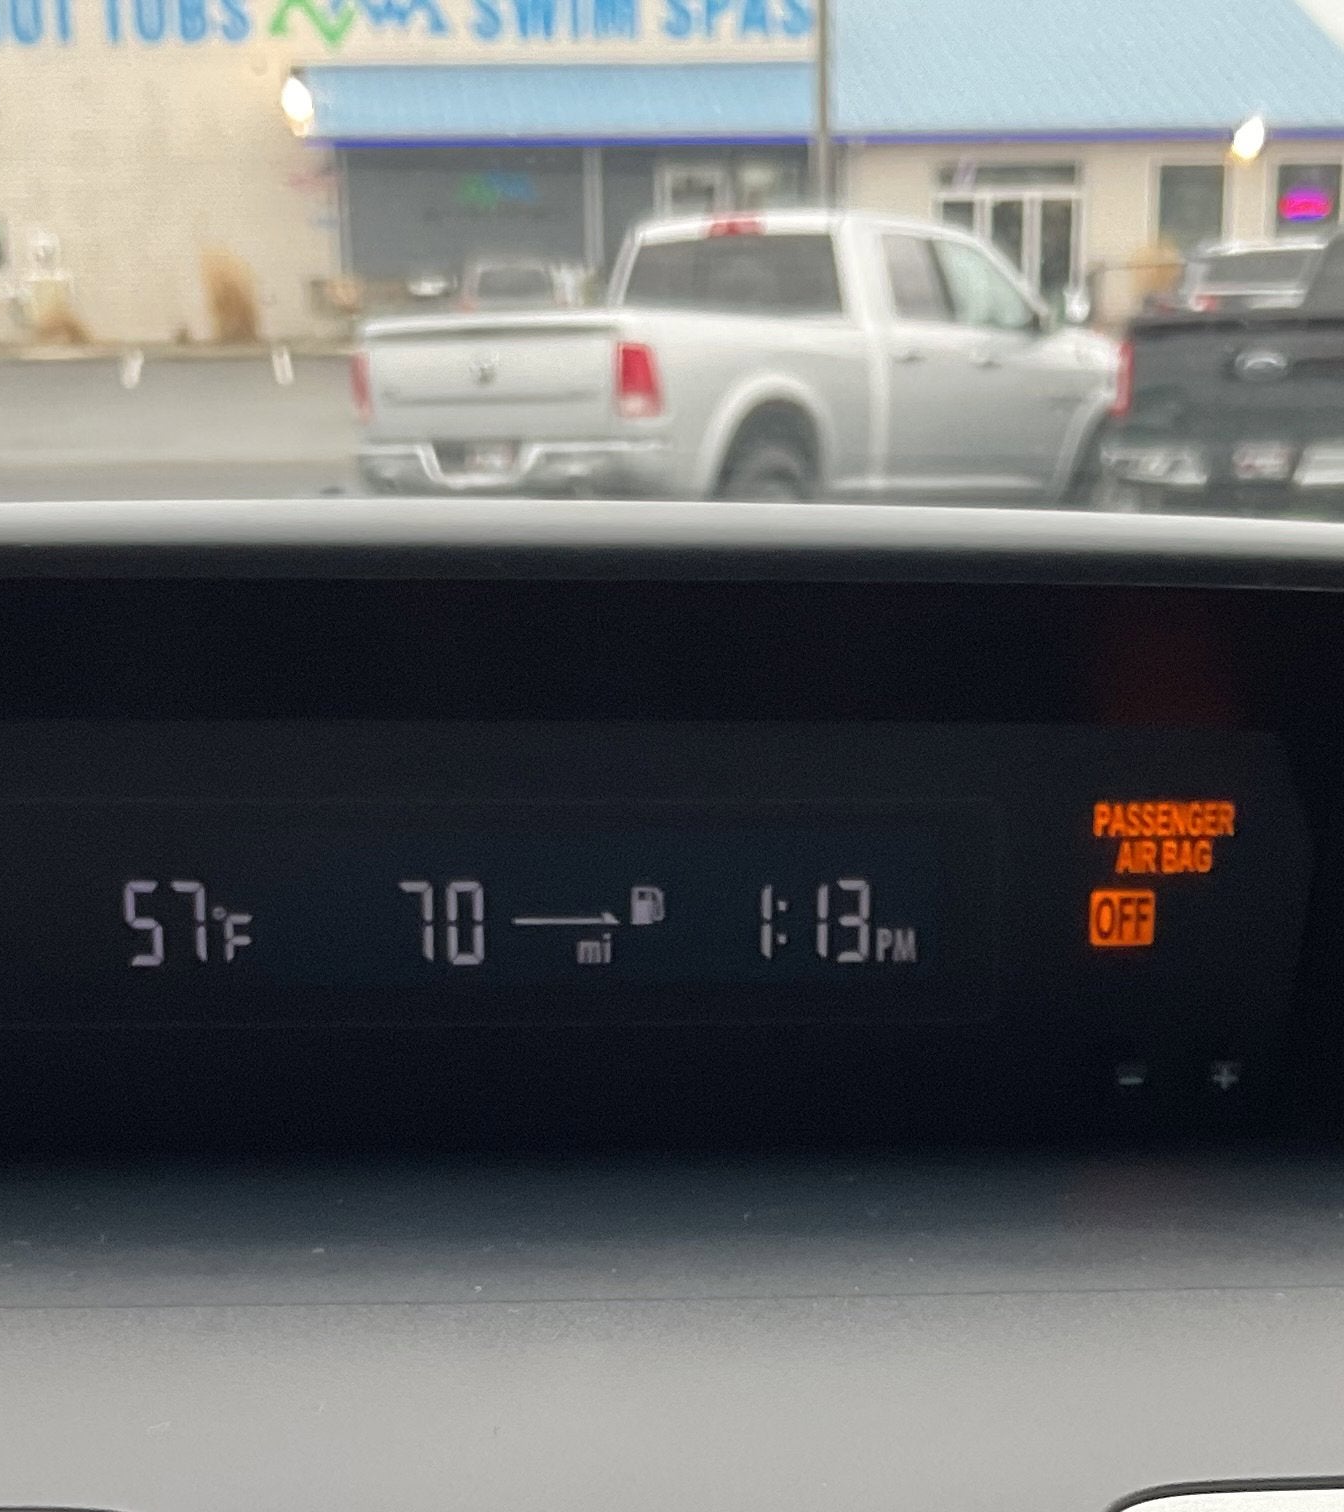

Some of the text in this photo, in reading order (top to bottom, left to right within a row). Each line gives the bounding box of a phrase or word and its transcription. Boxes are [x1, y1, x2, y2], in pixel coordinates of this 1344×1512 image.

[104, 0, 251, 44] TUBS
[470, 0, 813, 41] SWIM SPAS
[1092, 801, 1236, 837] PASSENGER
[1116, 838, 1213, 874] AIR BAG
[398, 880, 485, 966] 70
[1095, 896, 1152, 940] OFF
[576, 932, 612, 964] mi
